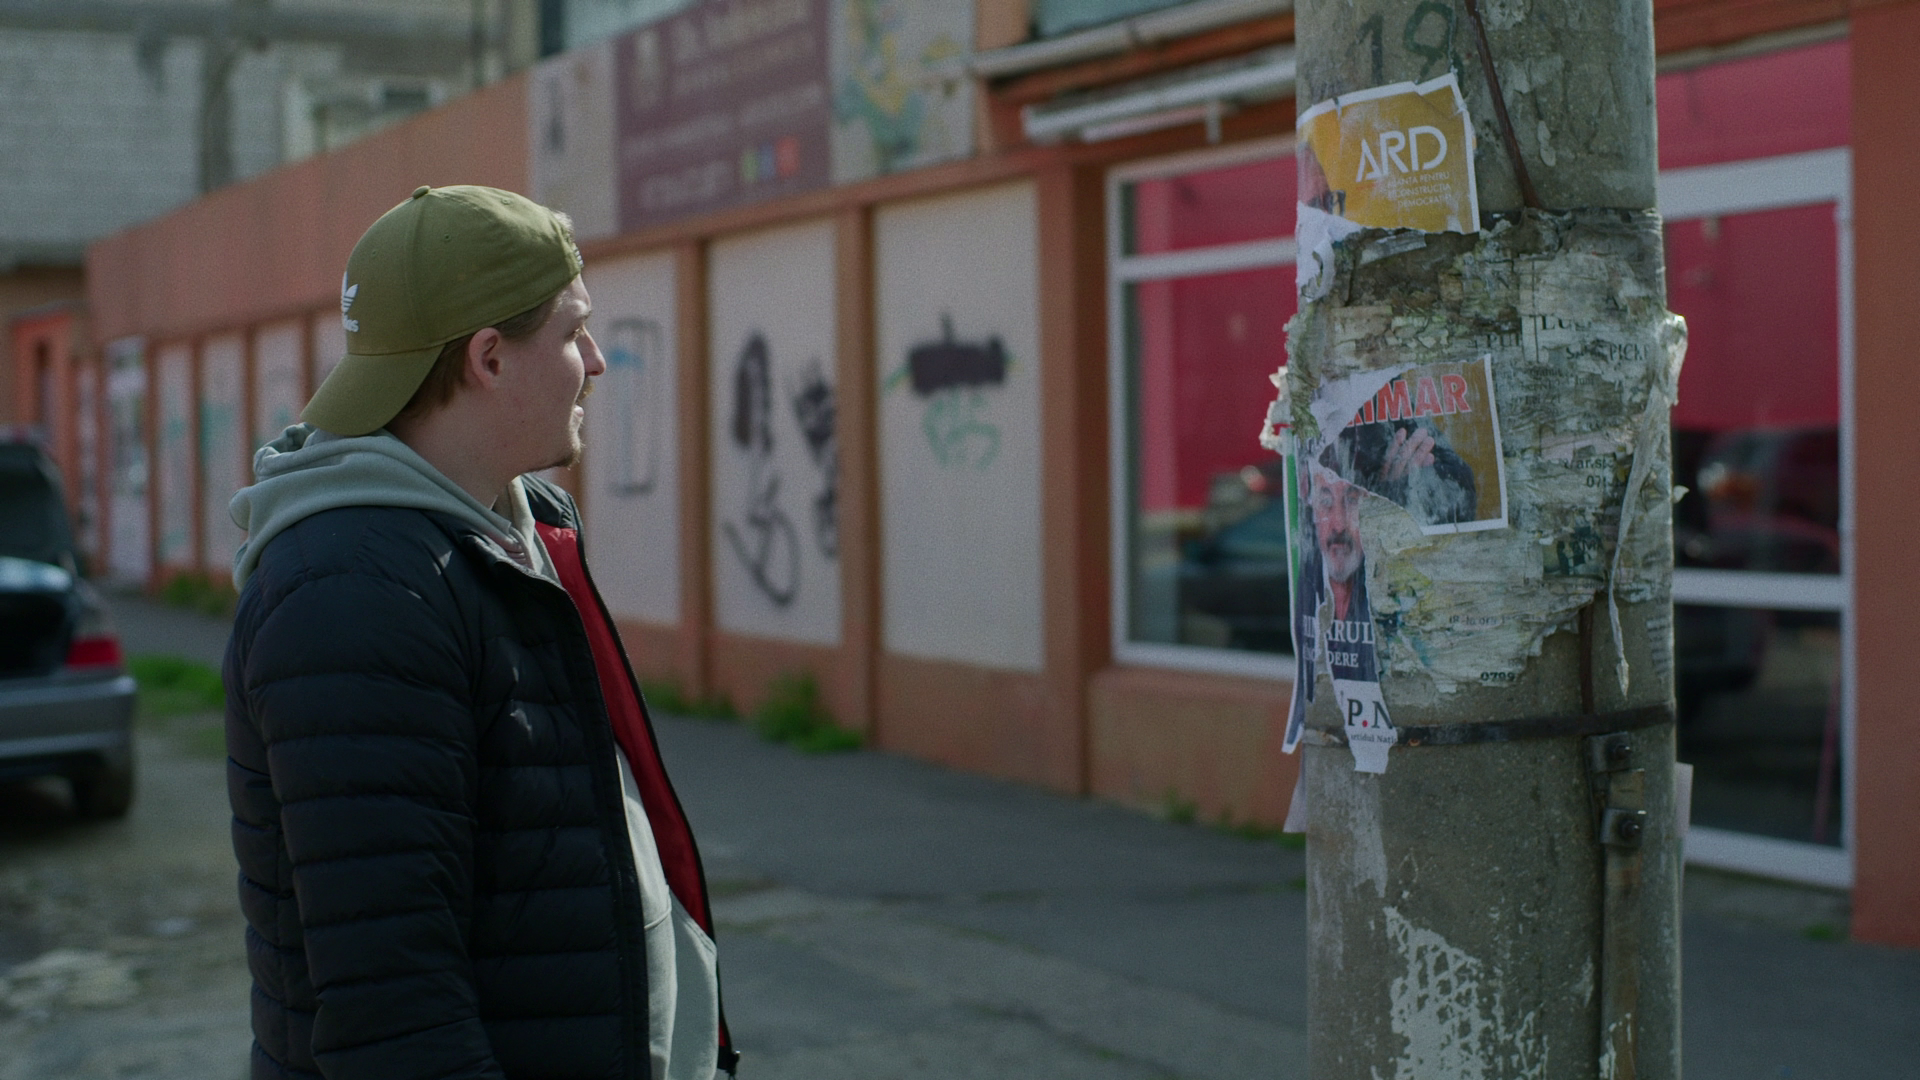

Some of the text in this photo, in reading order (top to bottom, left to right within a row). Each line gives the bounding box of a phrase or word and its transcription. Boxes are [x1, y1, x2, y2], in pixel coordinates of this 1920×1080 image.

[1356, 126, 1448, 182] ARD
[1420, 171, 1450, 183] PENTRU
[1348, 374, 1472, 427] IMAR
